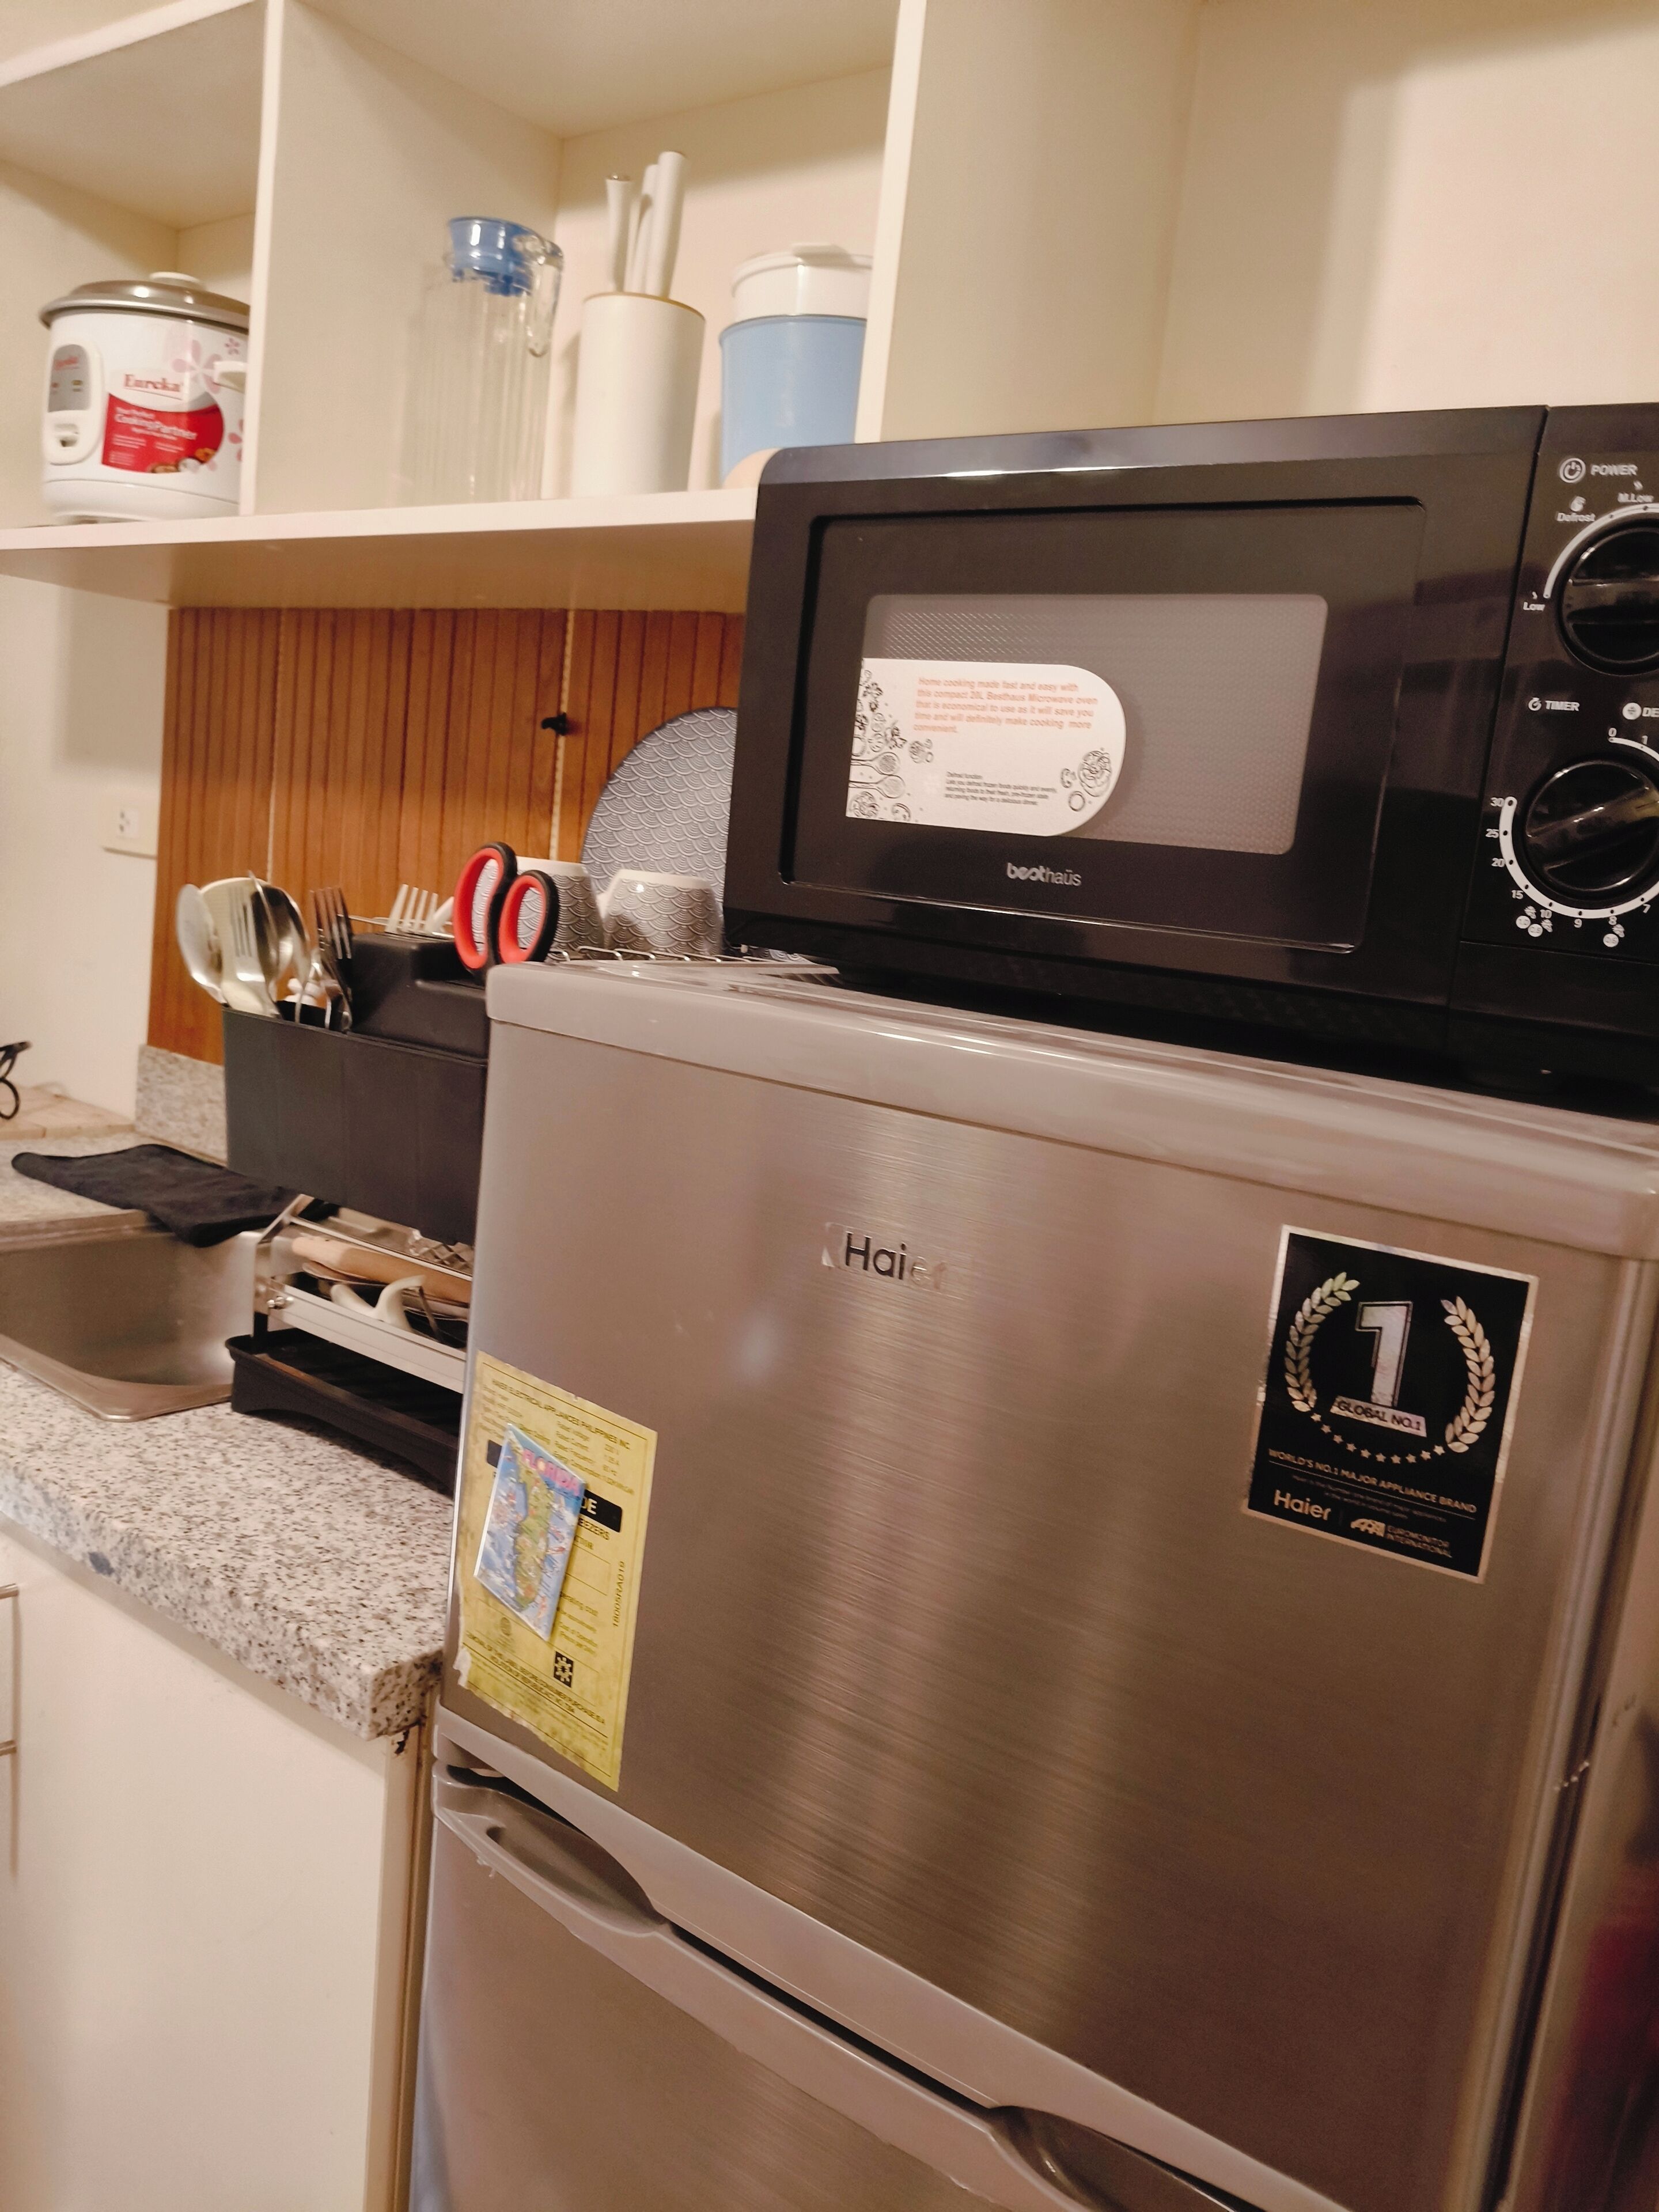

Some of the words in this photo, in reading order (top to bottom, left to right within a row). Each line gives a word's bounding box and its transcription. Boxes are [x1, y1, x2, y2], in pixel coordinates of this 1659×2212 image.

[124, 374, 181, 393] Eureka
[1590, 464, 1638, 476] POWER
[1556, 512, 1596, 522] Defrost
[1523, 602, 1546, 611] Low
[944, 680, 975, 690] cooking
[978, 680, 999, 688] made
[1002, 681, 1018, 689] fast
[1020, 682, 1036, 690] and
[1038, 684, 1056, 692] easy
[1060, 683, 1079, 692] with
[918, 689, 931, 697] this
[934, 691, 968, 700] compact
[1028, 694, 1074, 704] Microwave
[942, 703, 987, 711] economical
[1030, 706, 1036, 714] it
[1038, 706, 1052, 714] will
[1054, 708, 1074, 716] save
[1077, 709, 1094, 718] you
[1545, 700, 1580, 711] TIMER
[950, 714, 964, 722] will
[966, 715, 1002, 726] definitely
[1005, 717, 1028, 726] make
[1029, 718, 1065, 729] cooking
[1069, 721, 1092, 729] more
[1608, 728, 1617, 737] 0
[1642, 735, 1648, 745] 1
[1490, 797, 1505, 807] 30
[1485, 828, 1499, 839] 25
[1491, 858, 1505, 868] 20
[1511, 889, 1524, 900] 15
[1540, 909, 1552, 919] 10
[1642, 903, 1651, 914] 7
[1574, 918, 1582, 929] 9
[1608, 915, 1618, 926] 8
[845, 1230, 947, 1290] Haier
[1337, 1400, 1387, 1422] GLOBAL
[1391, 1415, 1421, 1431] NO.1
[1268, 1448, 1313, 1468] WORLD'S
[1315, 1461, 1338, 1475] NO.1
[1340, 1469, 1378, 1486] MAJOR
[1379, 1480, 1438, 1503] APPLIANCE
[1439, 1496, 1478, 1513] BRAND
[1274, 1489, 1331, 1521] Haier
[579, 1518, 609, 1540] EEZERS
